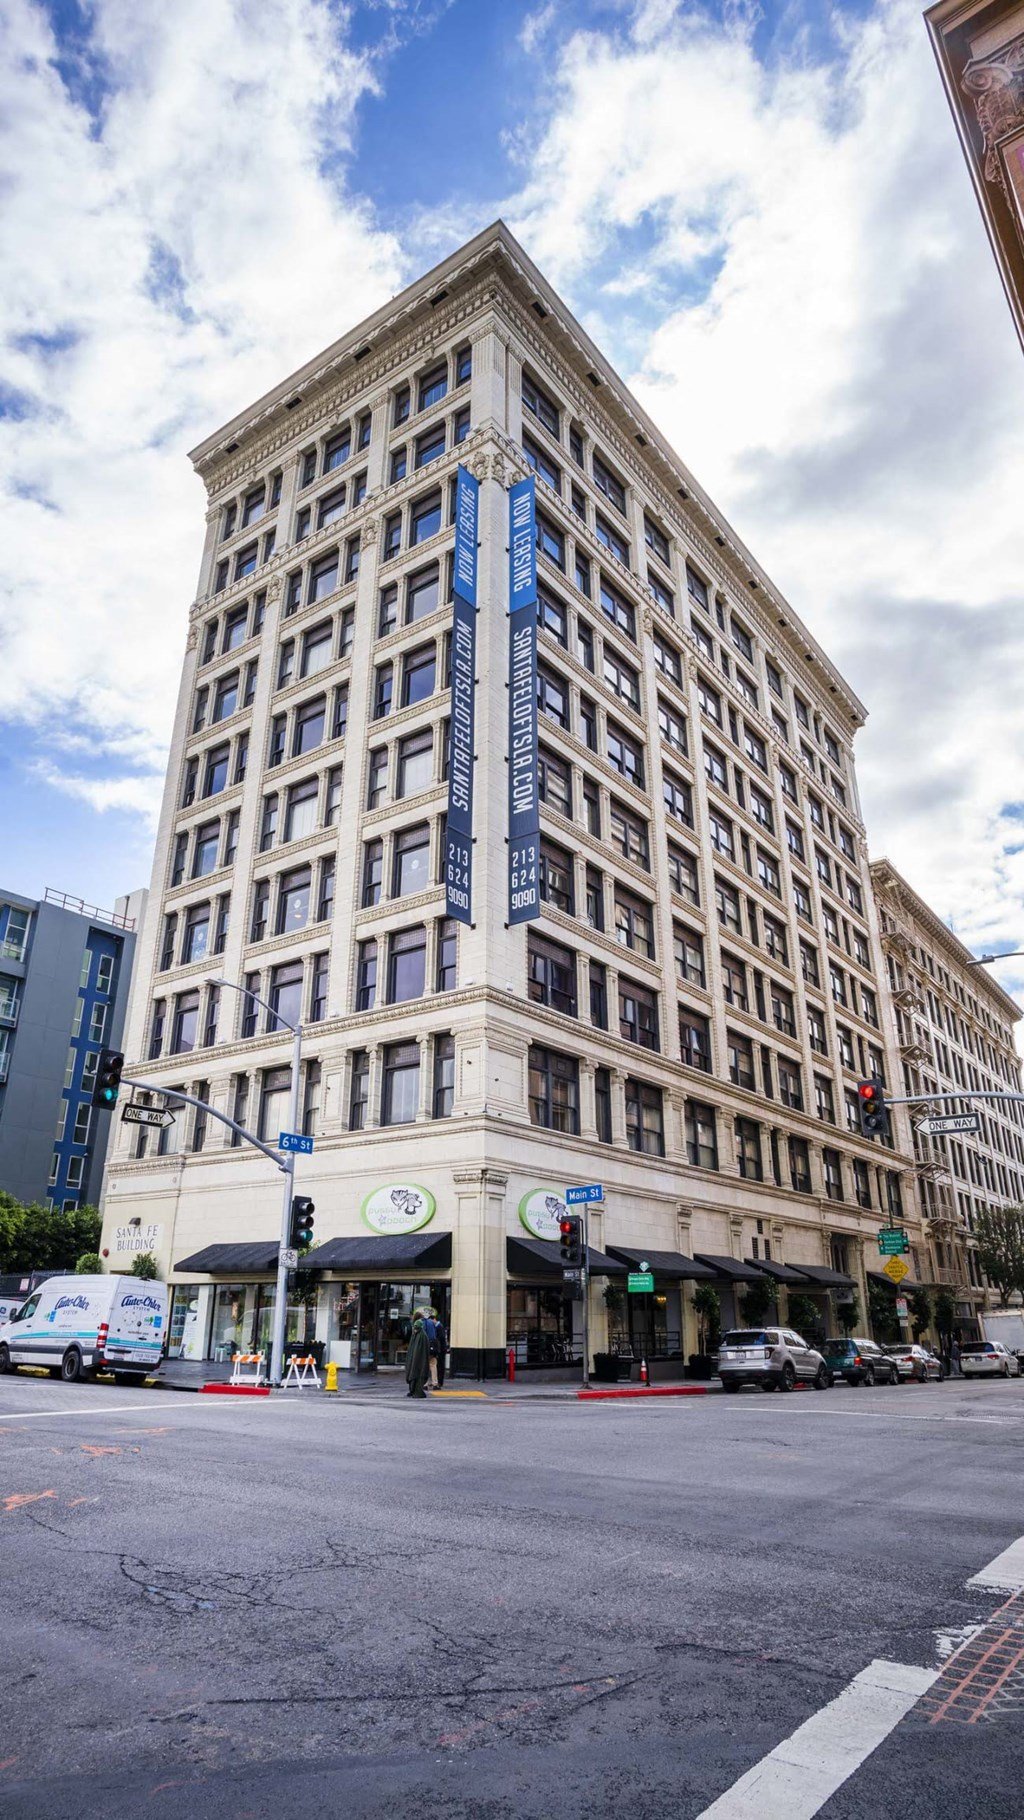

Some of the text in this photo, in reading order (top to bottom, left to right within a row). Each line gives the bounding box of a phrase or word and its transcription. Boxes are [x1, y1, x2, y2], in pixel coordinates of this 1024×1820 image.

[458, 483, 475, 587] NOW LEASING
[513, 492, 532, 592] NOW LEASING
[452, 618, 472, 812] SANTAFELOFTSLA.COM
[513, 626, 534, 814] SANTAFELOFTSLA.COM
[449, 843, 468, 866] 213
[512, 846, 535, 867] 213
[448, 864, 469, 888] 624
[511, 866, 536, 888] 624
[448, 886, 469, 910] 9090
[511, 888, 536, 910] 9090
[126, 1108, 164, 1122] ONE WAY
[929, 1118, 973, 1131] ONE WAY
[282, 1136, 310, 1150] 6th St
[569, 1188, 599, 1200] Main St
[116, 1224, 159, 1239] SANTA FE
[117, 1238, 155, 1251] BUILDING
